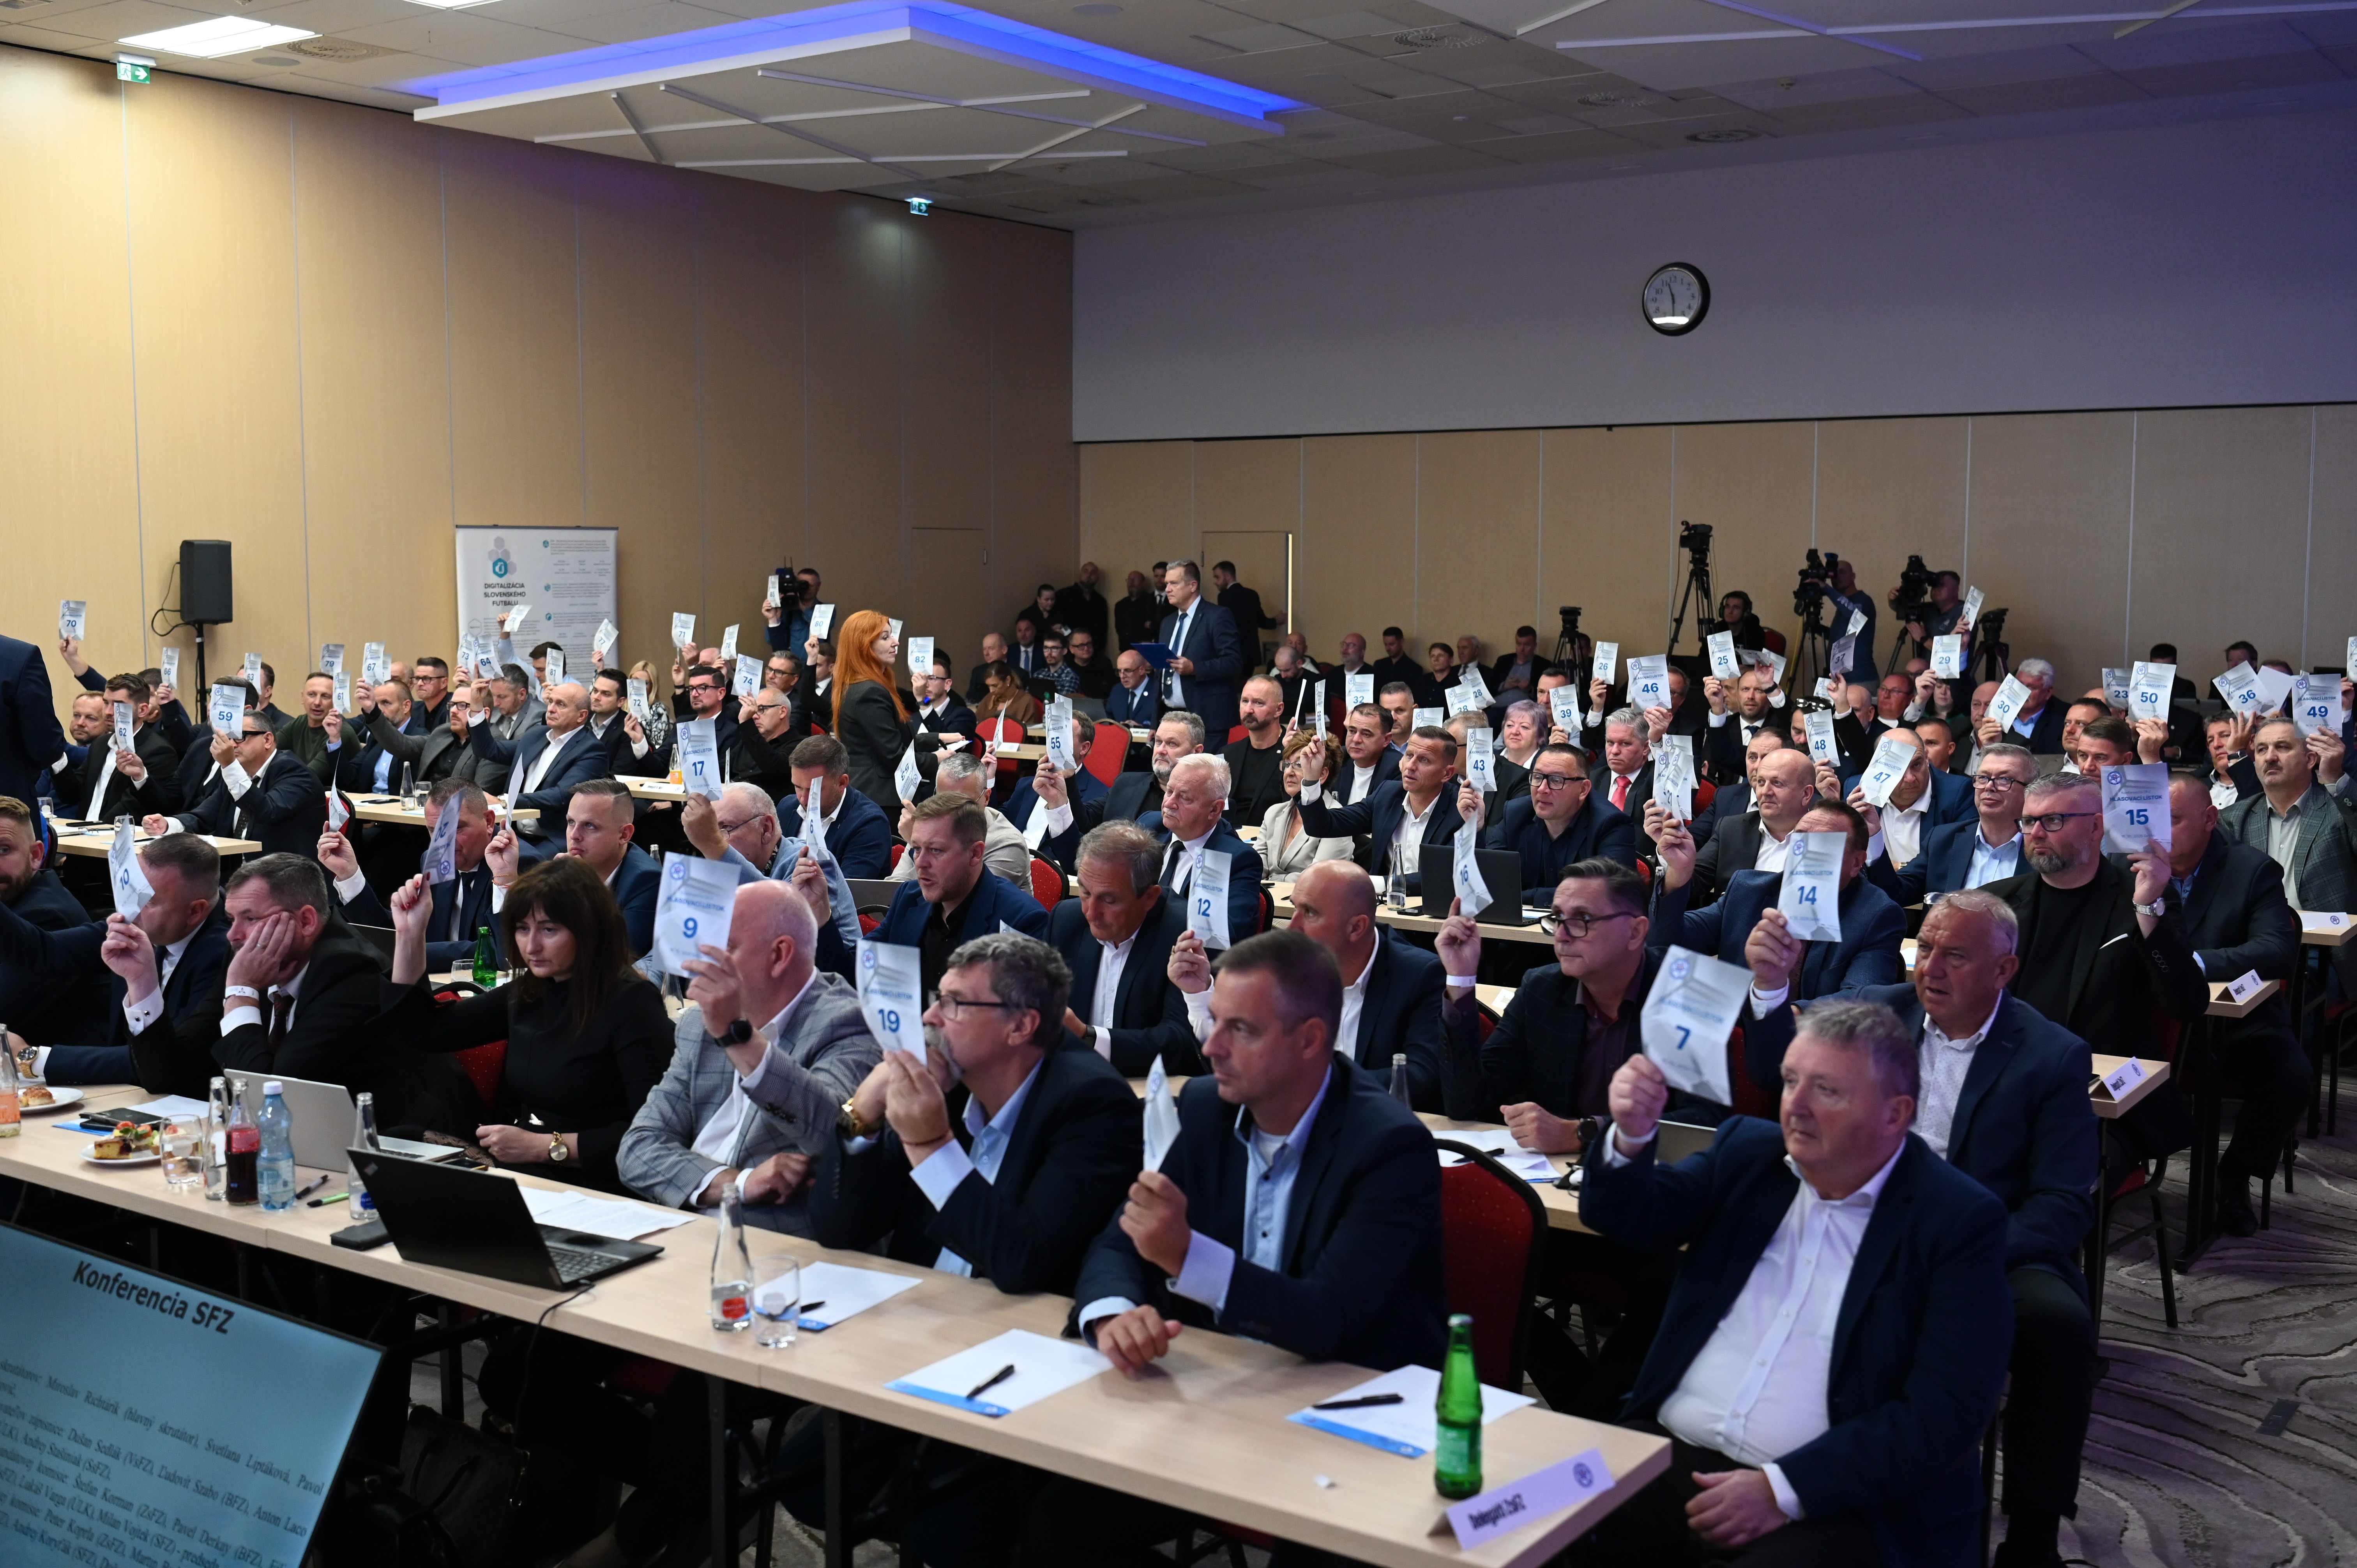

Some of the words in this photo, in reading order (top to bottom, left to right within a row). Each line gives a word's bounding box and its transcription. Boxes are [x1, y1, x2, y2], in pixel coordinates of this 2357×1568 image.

[599, 636, 606, 645] 77
[461, 652, 470, 660] 73
[480, 657, 491, 666] 64
[1717, 655, 1728, 665] 25
[1835, 653, 1846, 664] 37
[1938, 656, 1951, 664] 29
[367, 663, 376, 671] 67
[550, 669, 556, 677] 81
[743, 676, 753, 685] 74
[1473, 689, 1482, 698] 28
[1642, 683, 1659, 693] 46
[2114, 690, 2128, 698] 23
[2140, 692, 2158, 703] 50
[2239, 690, 2256, 704] 36
[1998, 700, 2010, 713] 30
[2307, 706, 2329, 717] 49
[218, 711, 233, 721] 59
[1560, 709, 1572, 718] 39
[119, 727, 127, 737] 62
[1051, 736, 1061, 750] 55
[1815, 740, 1826, 750] 48
[692, 761, 705, 776] 17
[1473, 759, 1485, 771] 43
[1873, 772, 1891, 784] 47
[1667, 789, 1672, 807] 21
[2126, 809, 2149, 825] 15
[810, 819, 814, 834] 6
[120, 868, 129, 890] 10
[1460, 864, 1468, 885] 16
[1797, 885, 1817, 905] 14
[1198, 898, 1211, 918] 12
[683, 918, 697, 939] 9
[878, 1008, 900, 1033] 19
[1675, 1026, 1691, 1050] 7
[73, 1260, 189, 1319] Konferencia
[191, 1301, 235, 1334] SFZ
[297, 1475, 323, 1496] Pavol
[193, 1480, 220, 1501] Szabo
[253, 1505, 282, 1527] Anton
[284, 1517, 308, 1538] Laco
[172, 1518, 196, 1539] Pavel
